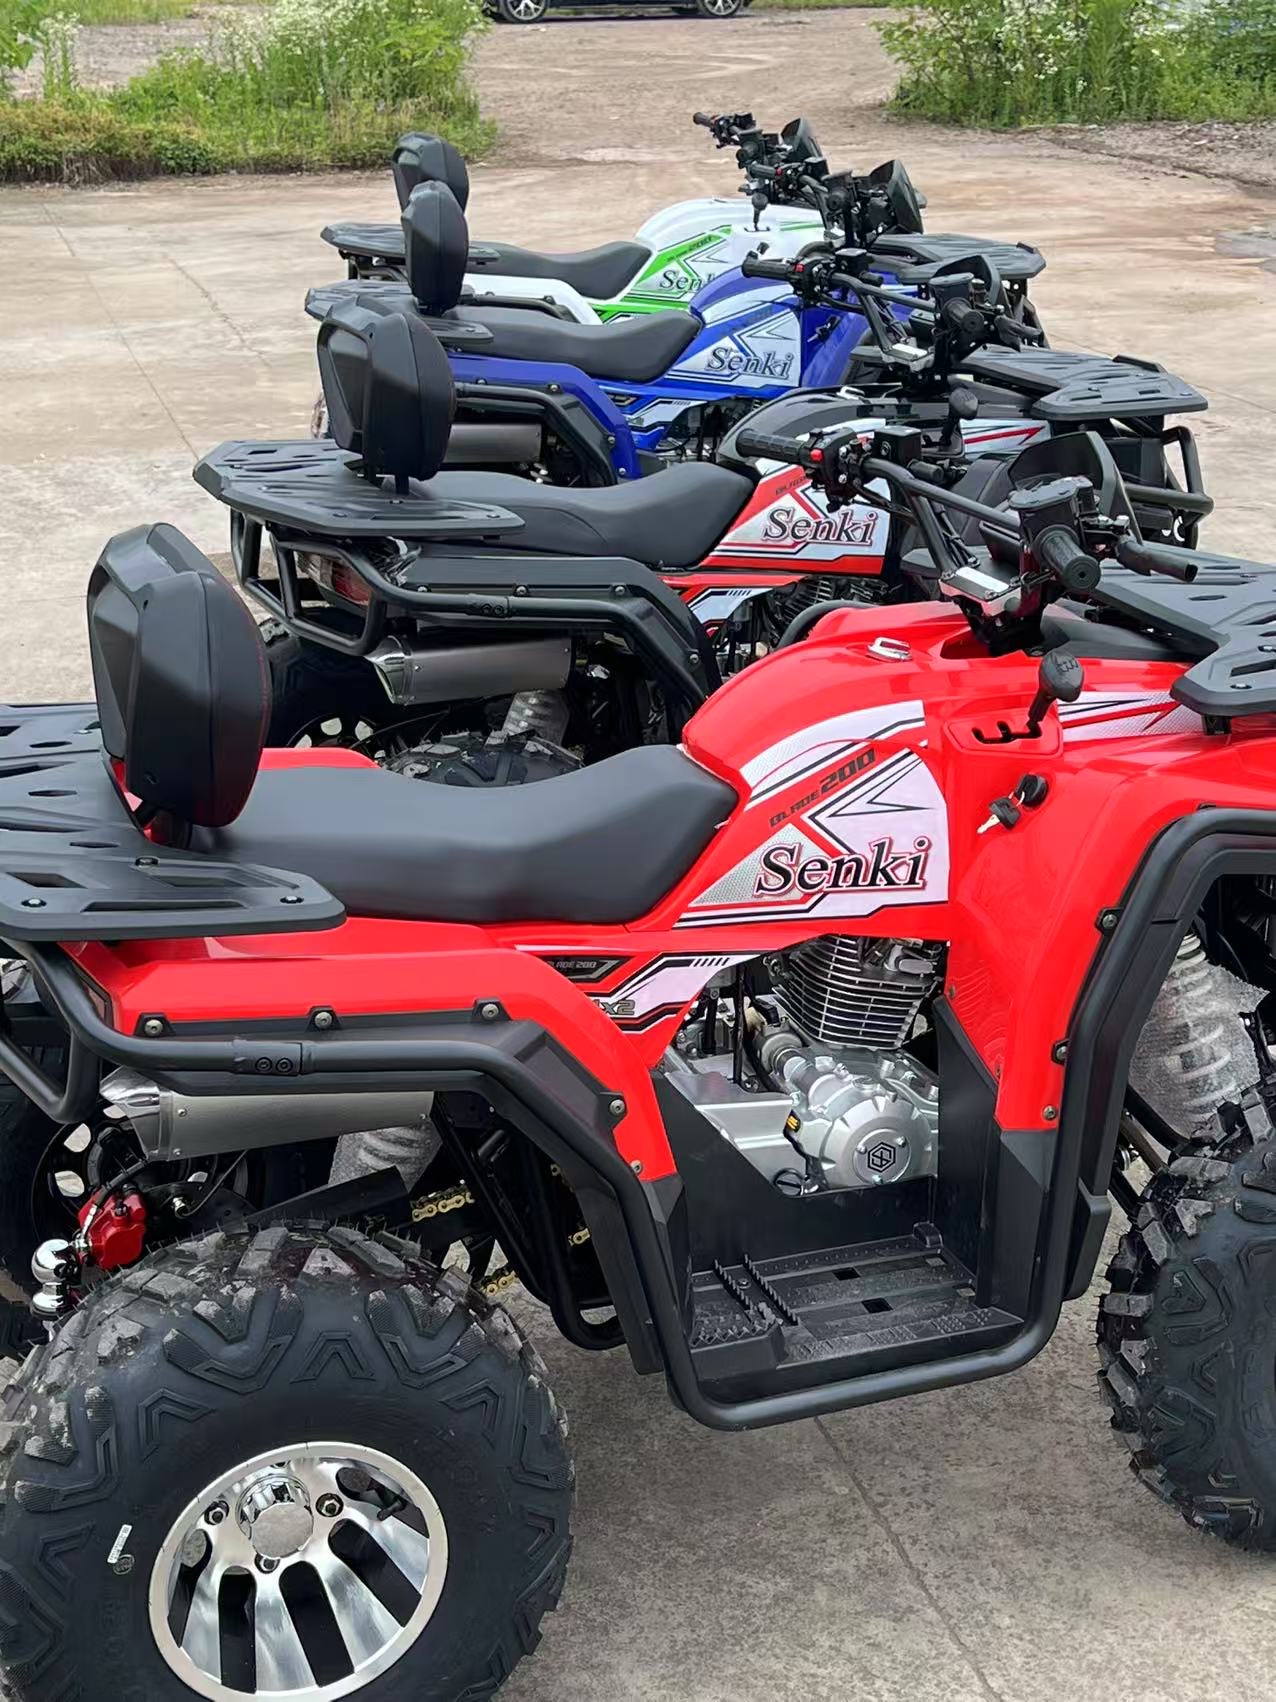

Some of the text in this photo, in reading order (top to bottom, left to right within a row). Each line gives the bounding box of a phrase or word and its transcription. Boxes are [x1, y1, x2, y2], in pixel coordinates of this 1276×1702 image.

[707, 348, 793, 380] Senki
[763, 507, 878, 546] Senki
[769, 749, 875, 828] BLADE 200
[755, 837, 931, 898] Senki
[575, 960, 597, 968] 200
